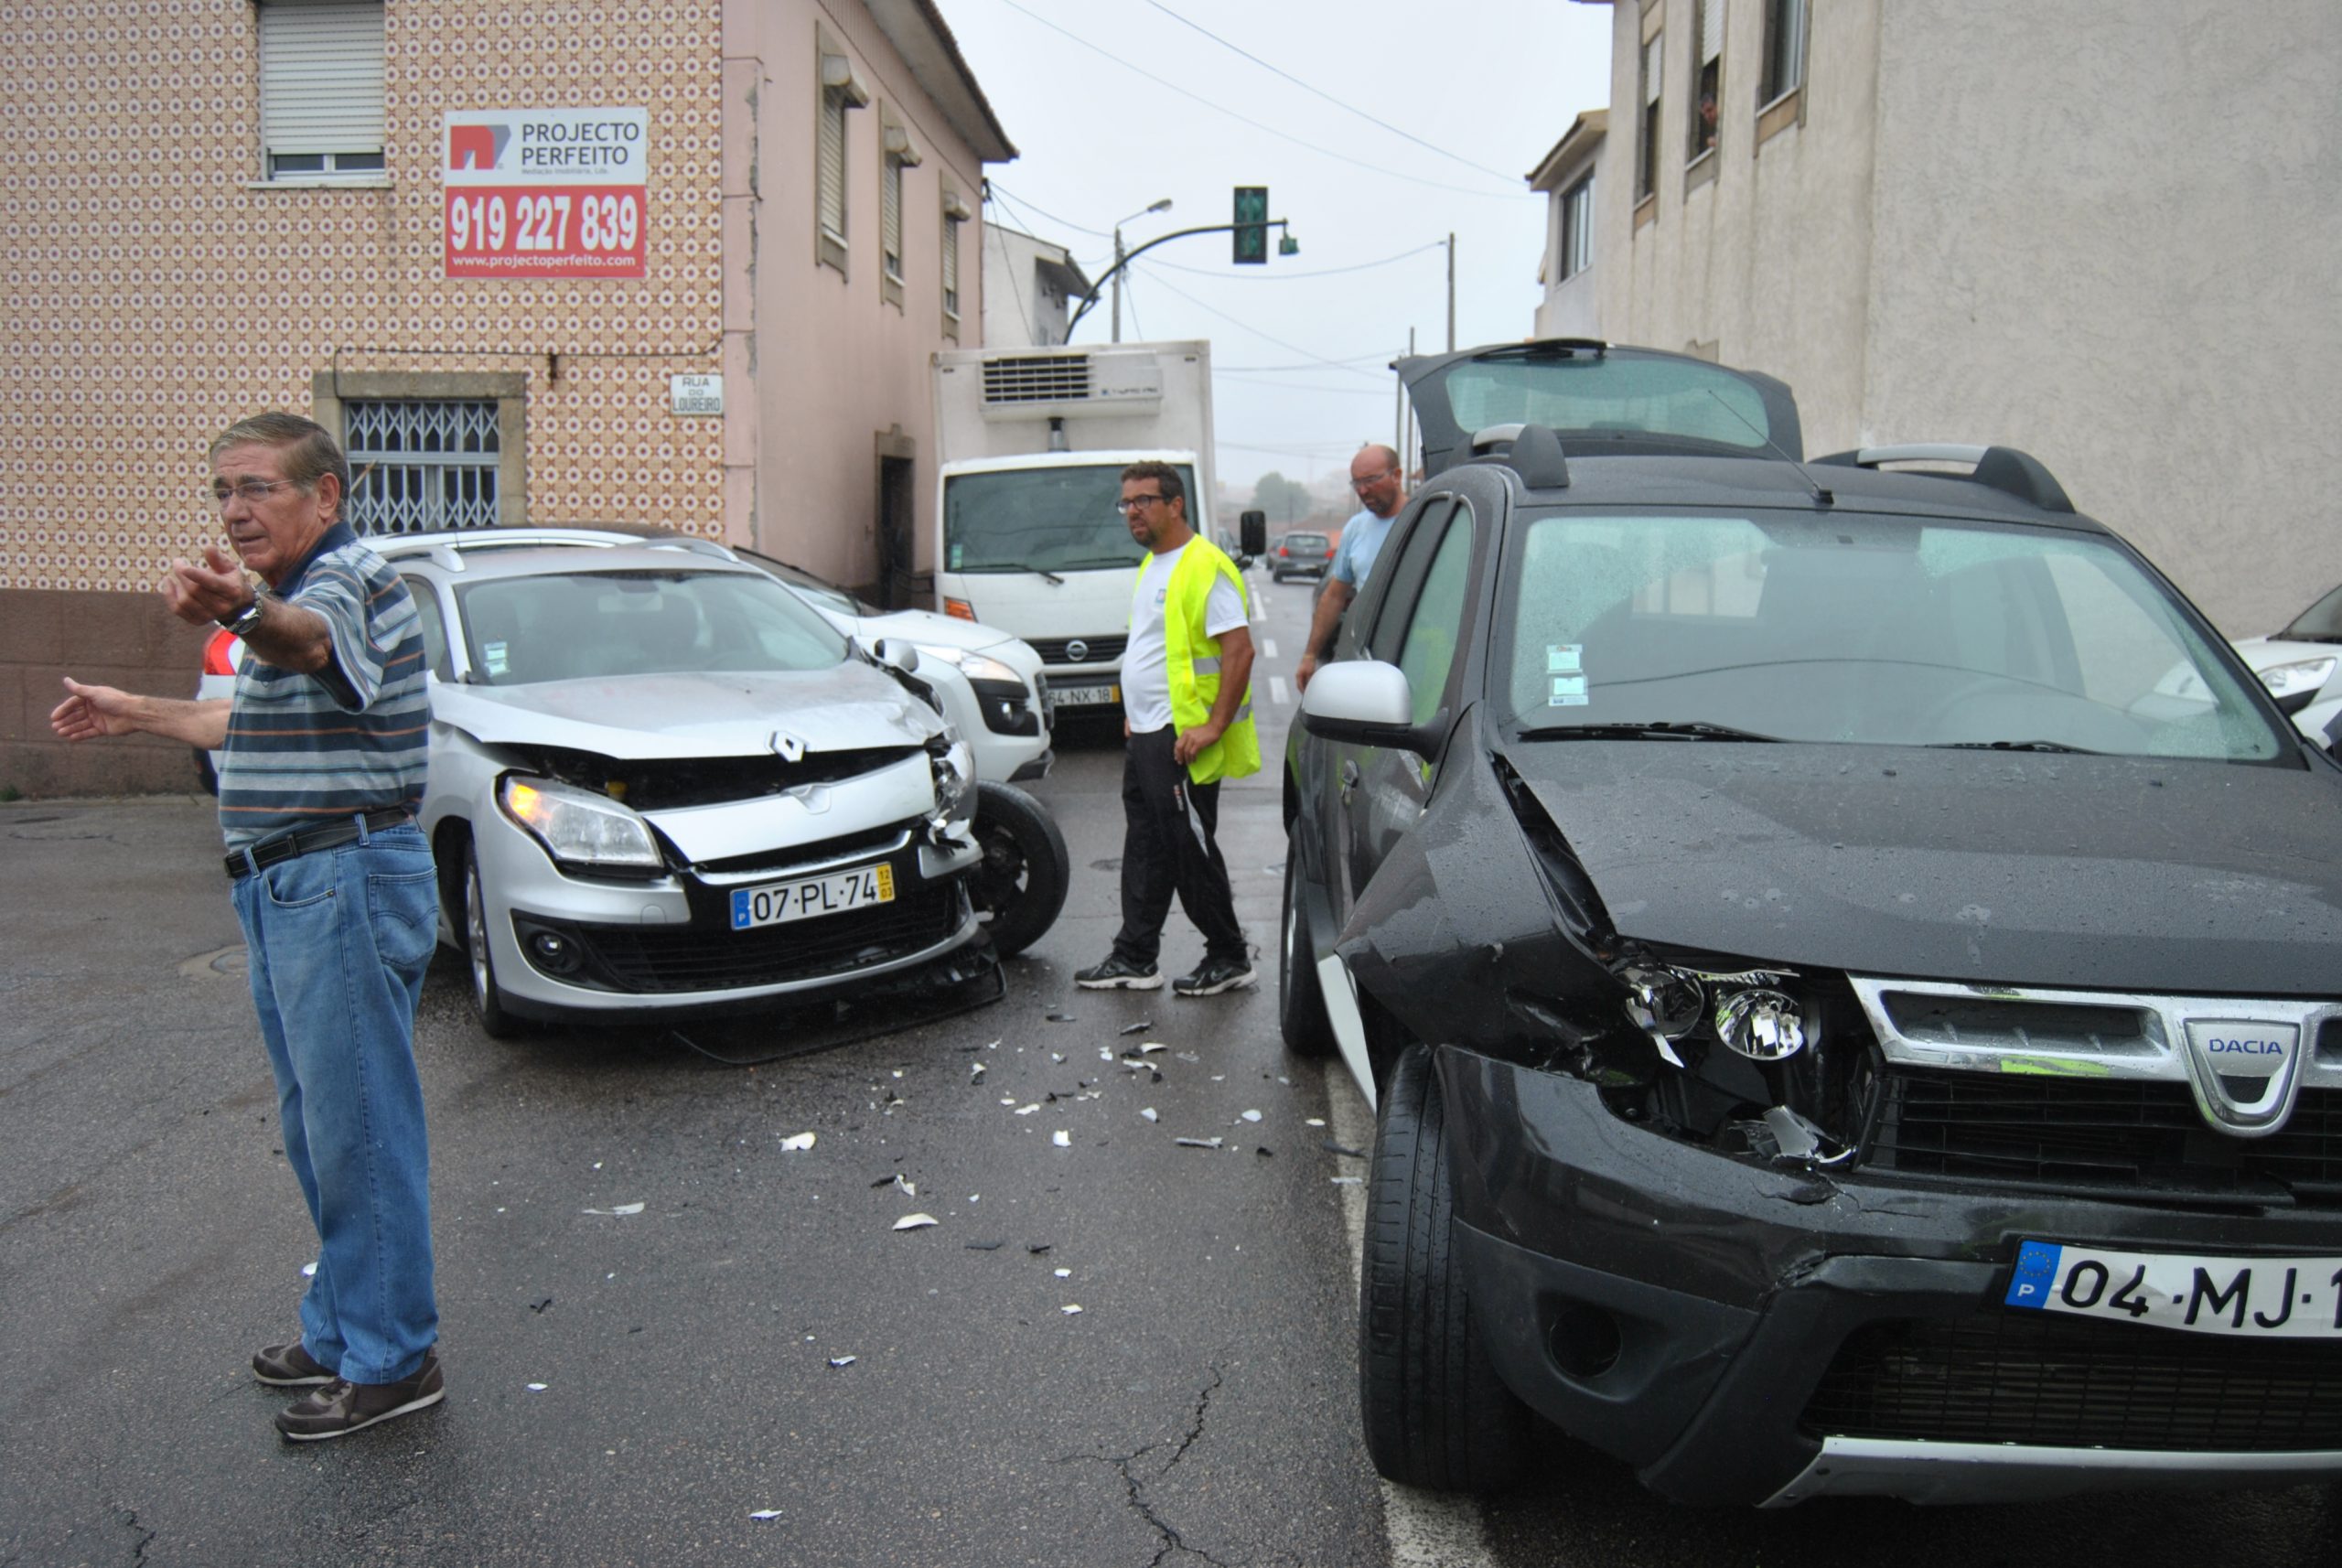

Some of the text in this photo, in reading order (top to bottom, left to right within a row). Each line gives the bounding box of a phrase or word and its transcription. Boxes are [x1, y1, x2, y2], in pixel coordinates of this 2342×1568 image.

[522, 123, 639, 142] PROJECTO
[522, 146, 628, 165] PERFEITO
[451, 195, 638, 251] 919 227 839
[452, 253, 636, 269] www.projectoperfeito.com
[682, 377, 709, 387] RUA
[672, 397, 721, 412] LOUREIRO
[738, 913, 746, 922] P
[2208, 1038, 2283, 1055] DACIA
[2017, 1283, 2035, 1297] P
